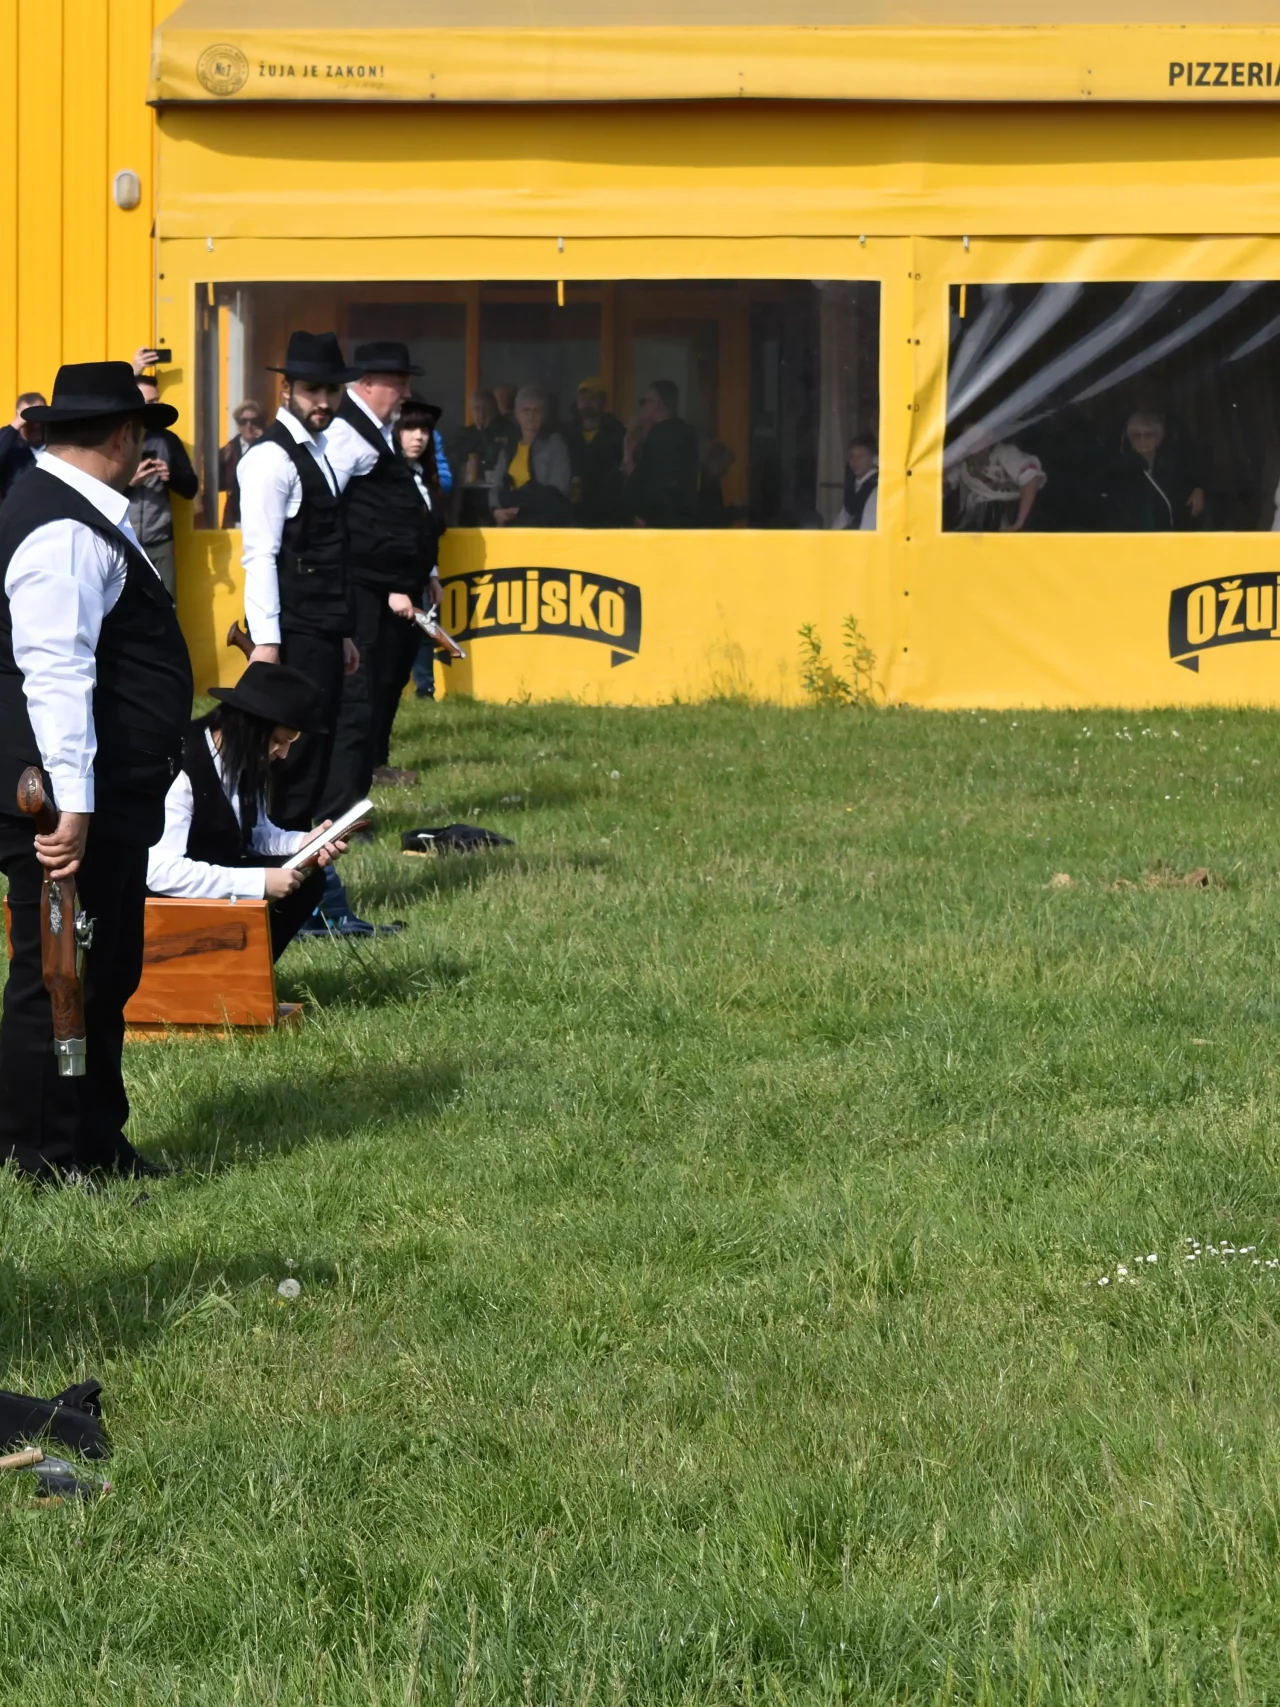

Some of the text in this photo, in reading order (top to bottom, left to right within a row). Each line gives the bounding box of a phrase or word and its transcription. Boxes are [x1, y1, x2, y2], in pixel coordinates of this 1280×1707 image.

[259, 61, 385, 78] ŽUJA JE ZAKON!
[439, 570, 625, 637] Ožujsko
